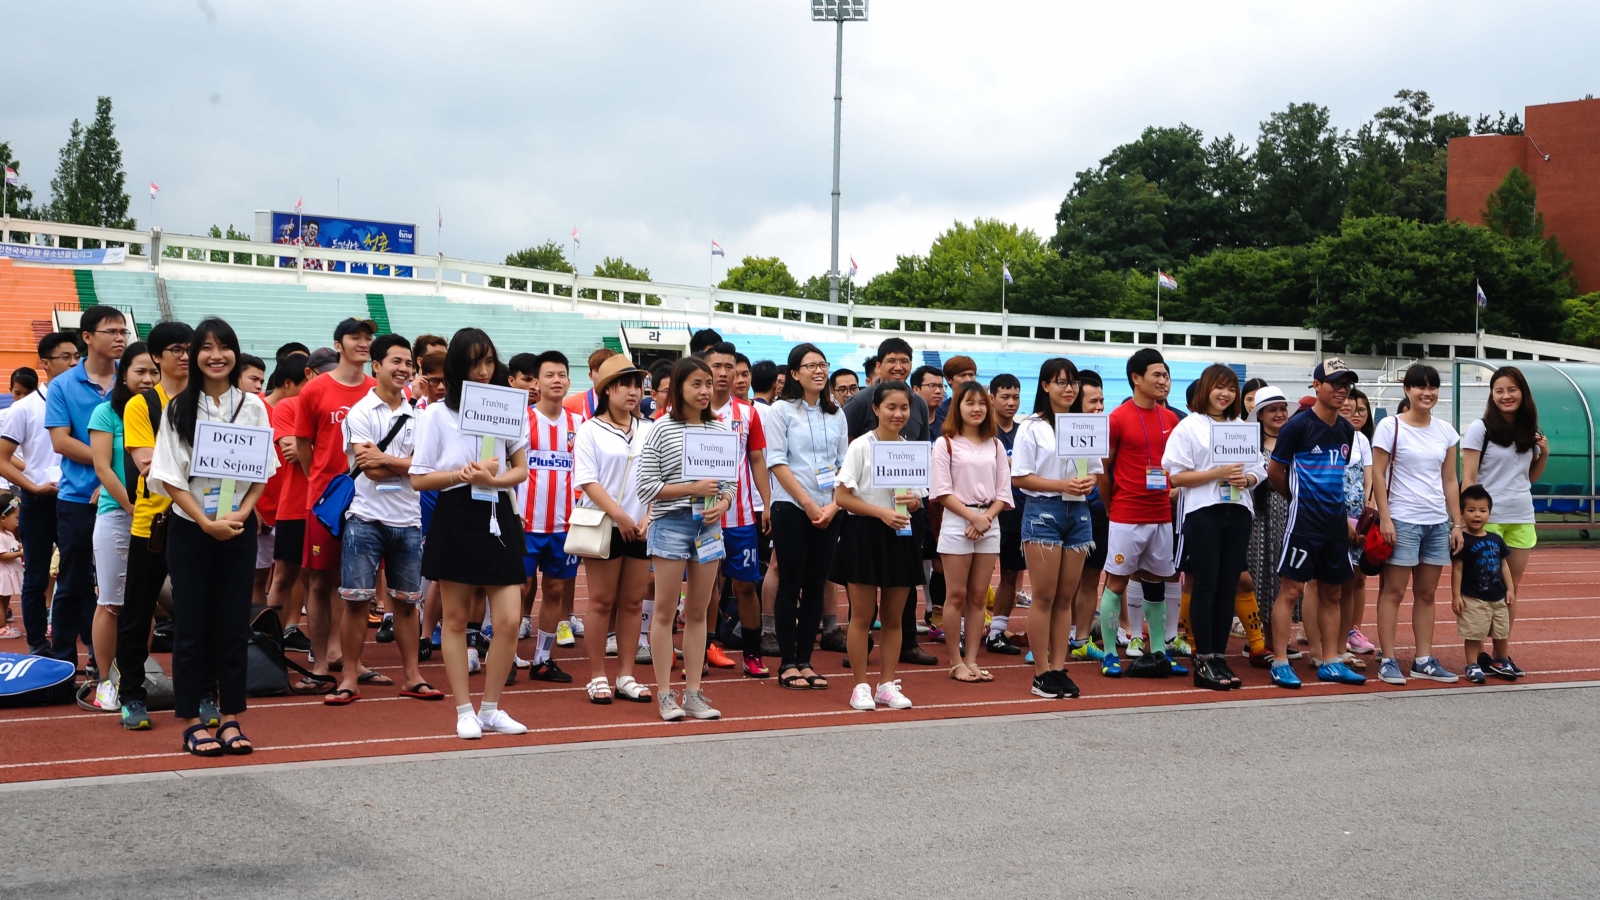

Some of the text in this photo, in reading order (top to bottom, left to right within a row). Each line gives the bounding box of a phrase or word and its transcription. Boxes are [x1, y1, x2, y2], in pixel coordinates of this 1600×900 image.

[649, 331, 661, 342] 라
[465, 409, 520, 426] Chungnam
[213, 431, 256, 446] DGIST
[1070, 435, 1096, 447] UST
[1214, 445, 1257, 455] Chonbuk
[1328, 449, 1339, 466] 17
[199, 456, 263, 475] KU Sejong
[687, 455, 735, 469] Yuengnam
[876, 465, 926, 477] Hannam
[743, 548, 757, 568] 24
[1289, 546, 1308, 569] 17
